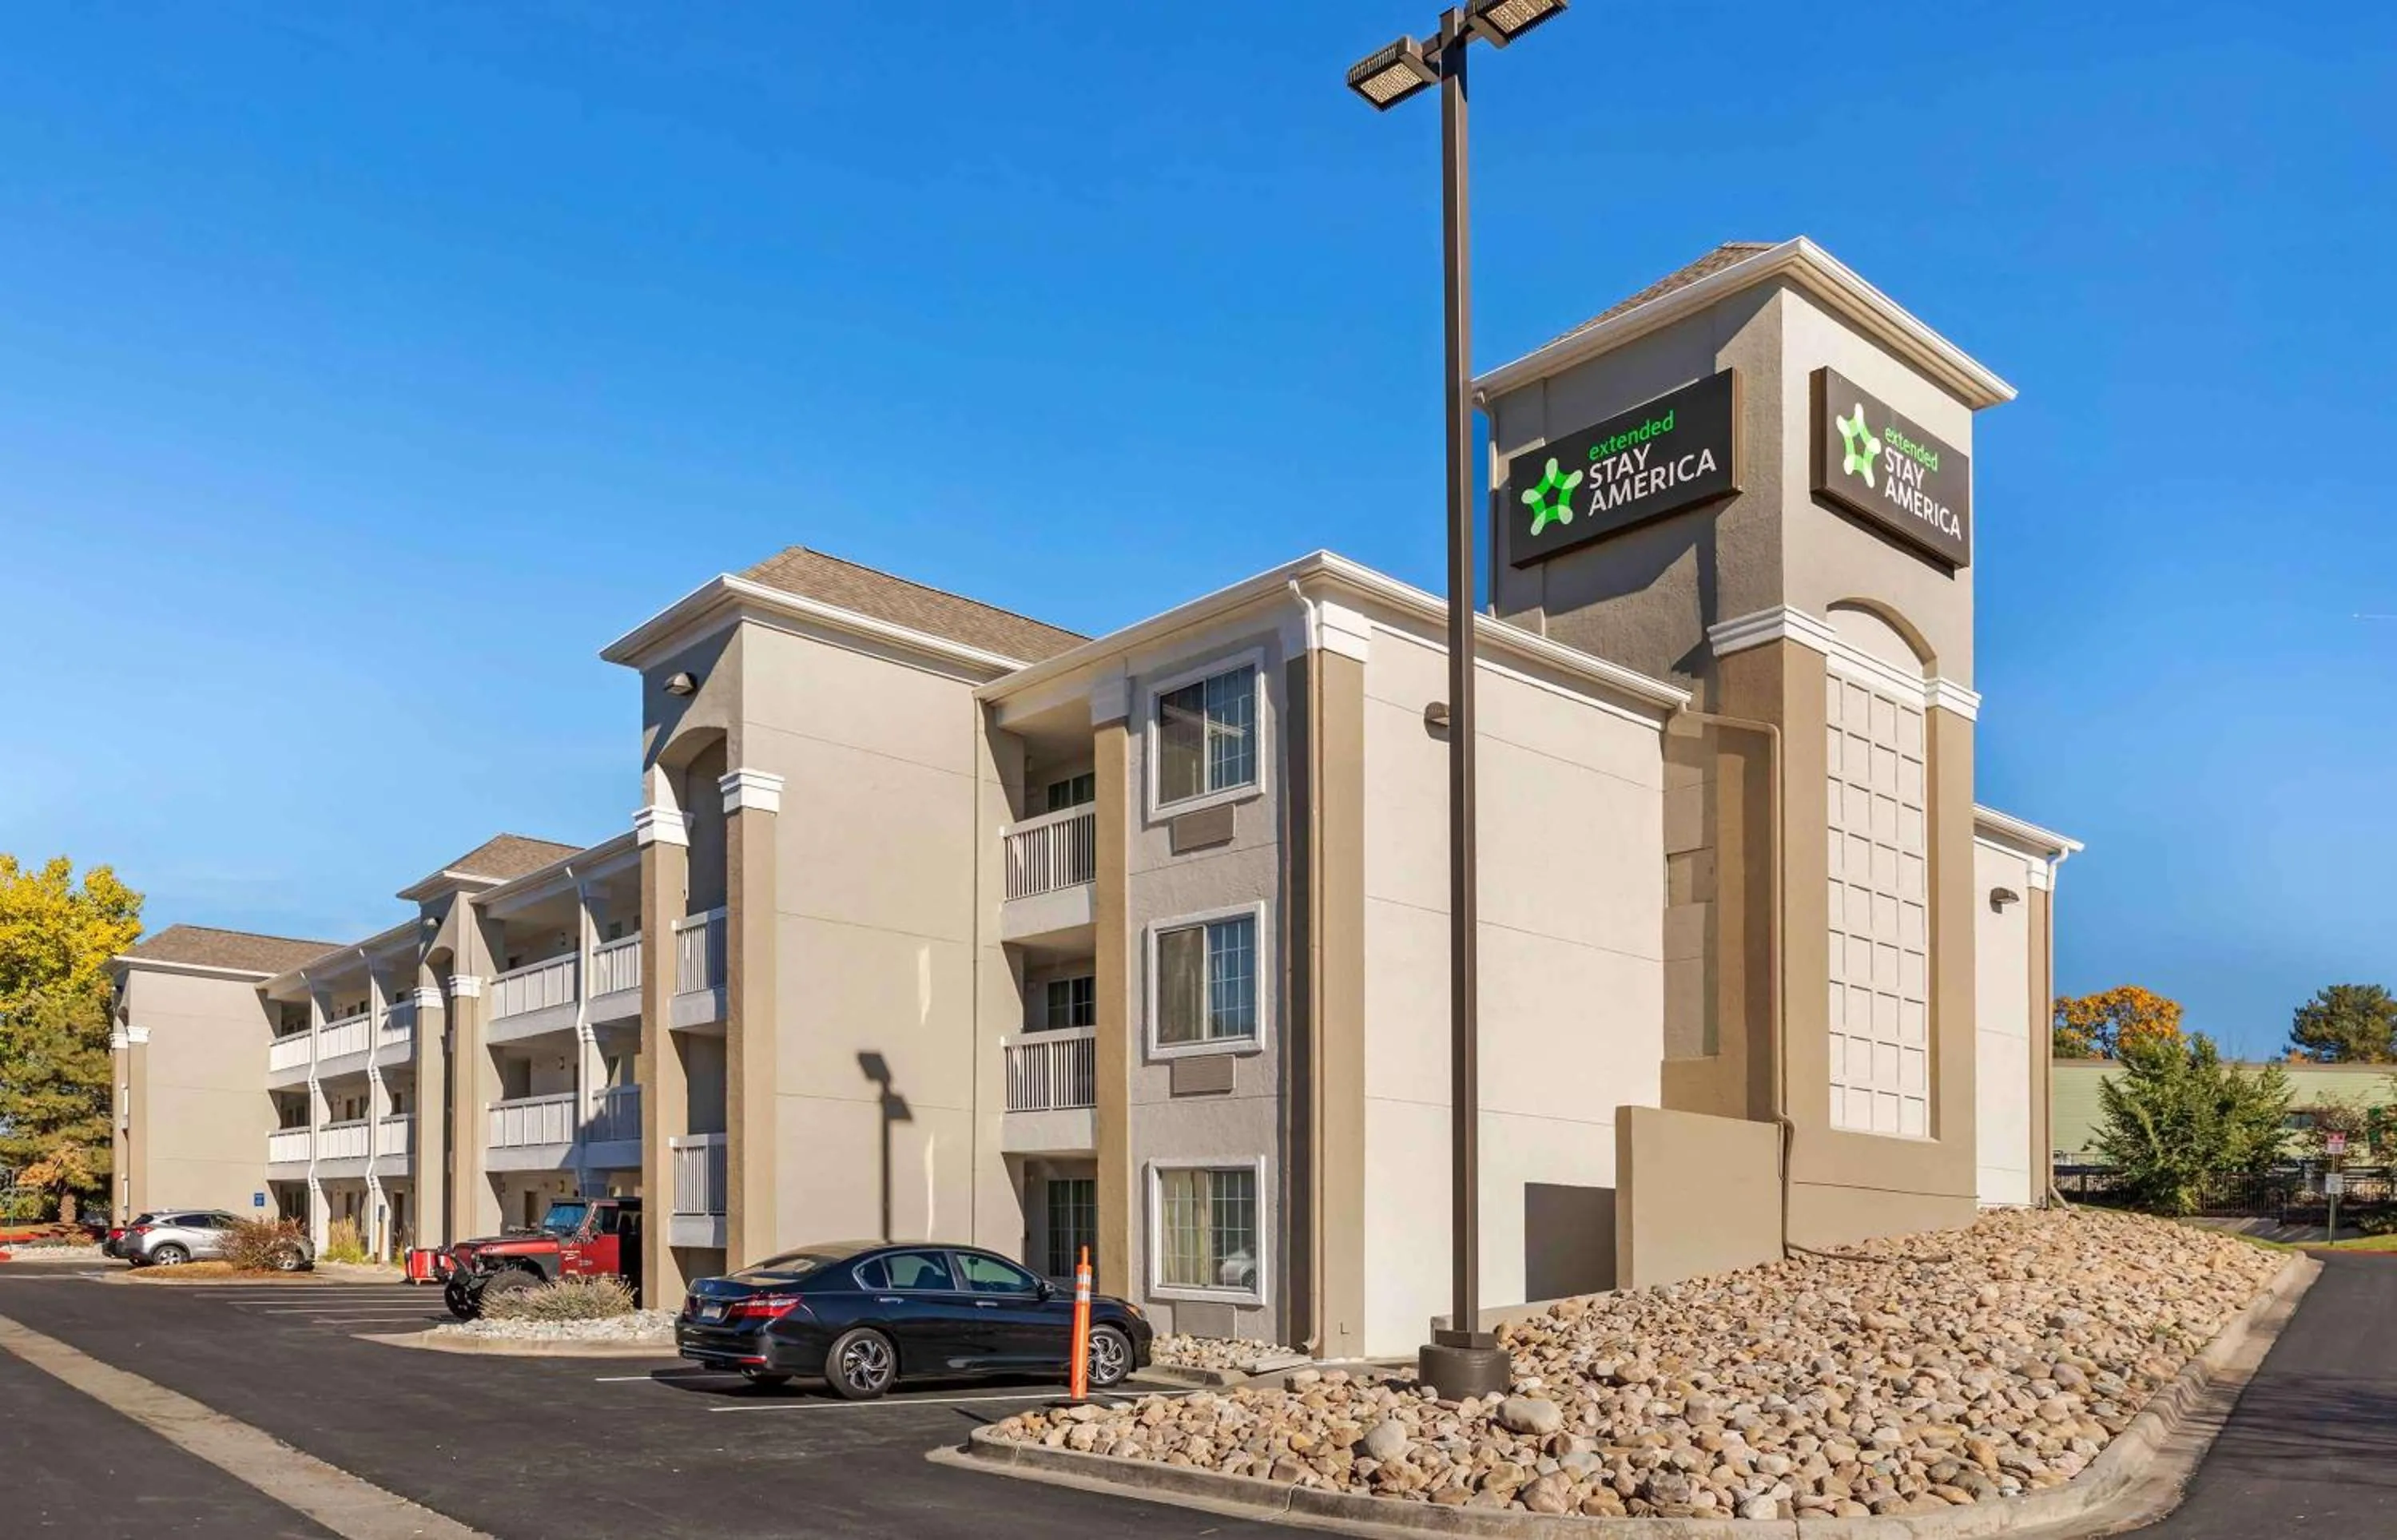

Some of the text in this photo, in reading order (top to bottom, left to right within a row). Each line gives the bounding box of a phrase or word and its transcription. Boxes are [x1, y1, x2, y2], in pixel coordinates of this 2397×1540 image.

[1588, 409, 1675, 461] extended
[1885, 427, 1938, 473] extended
[1588, 443, 1652, 489] STAY
[1588, 448, 1717, 517] AMERICA
[1885, 447, 1925, 490] STAY
[1885, 475, 1962, 541] AMERICA
